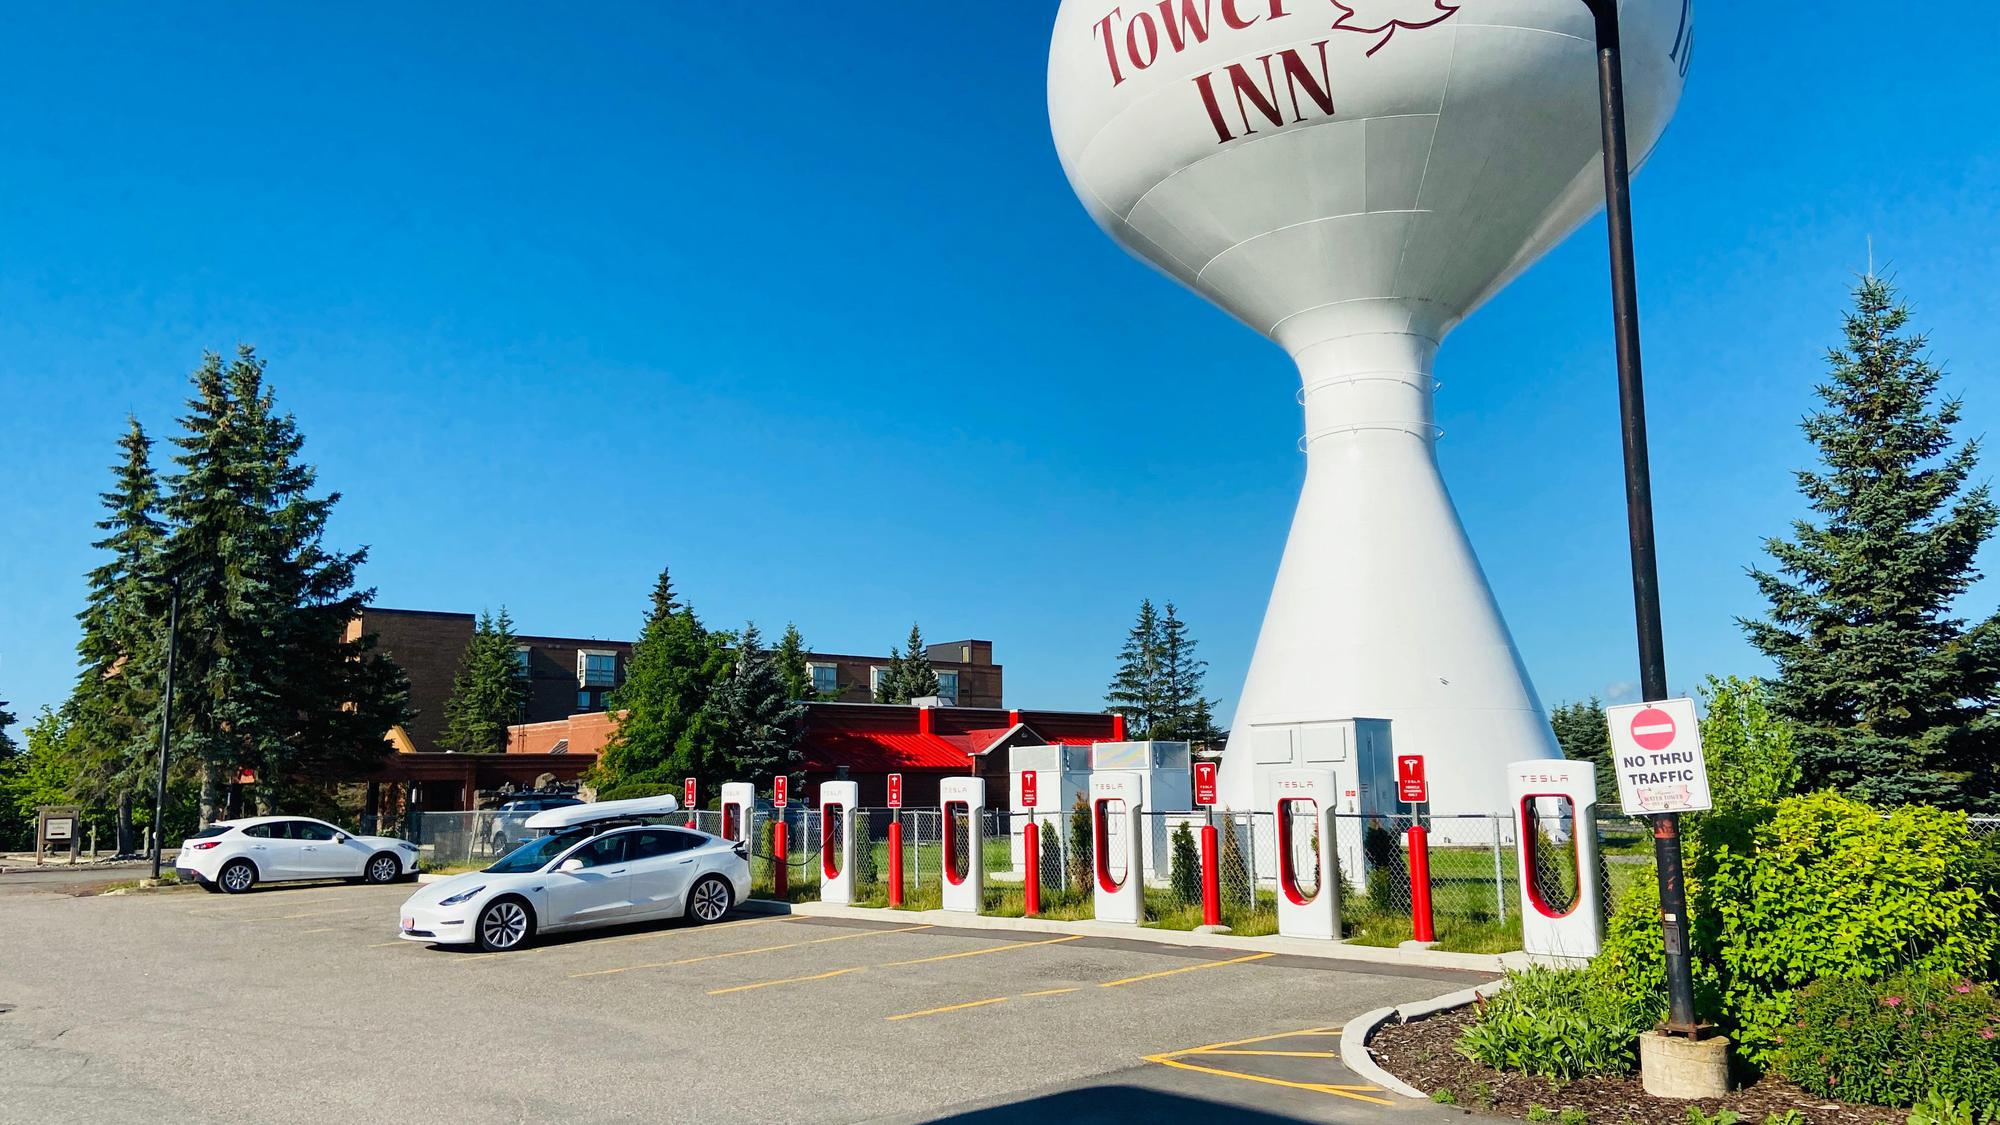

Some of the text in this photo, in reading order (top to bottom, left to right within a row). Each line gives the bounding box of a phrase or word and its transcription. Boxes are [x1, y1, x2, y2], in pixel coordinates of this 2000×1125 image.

[1192, 39, 1335, 144] INN
[1623, 751, 1693, 768] NO THRU
[1520, 774, 1569, 783] TESLA
[1629, 769, 1694, 785] TRAFFIC
